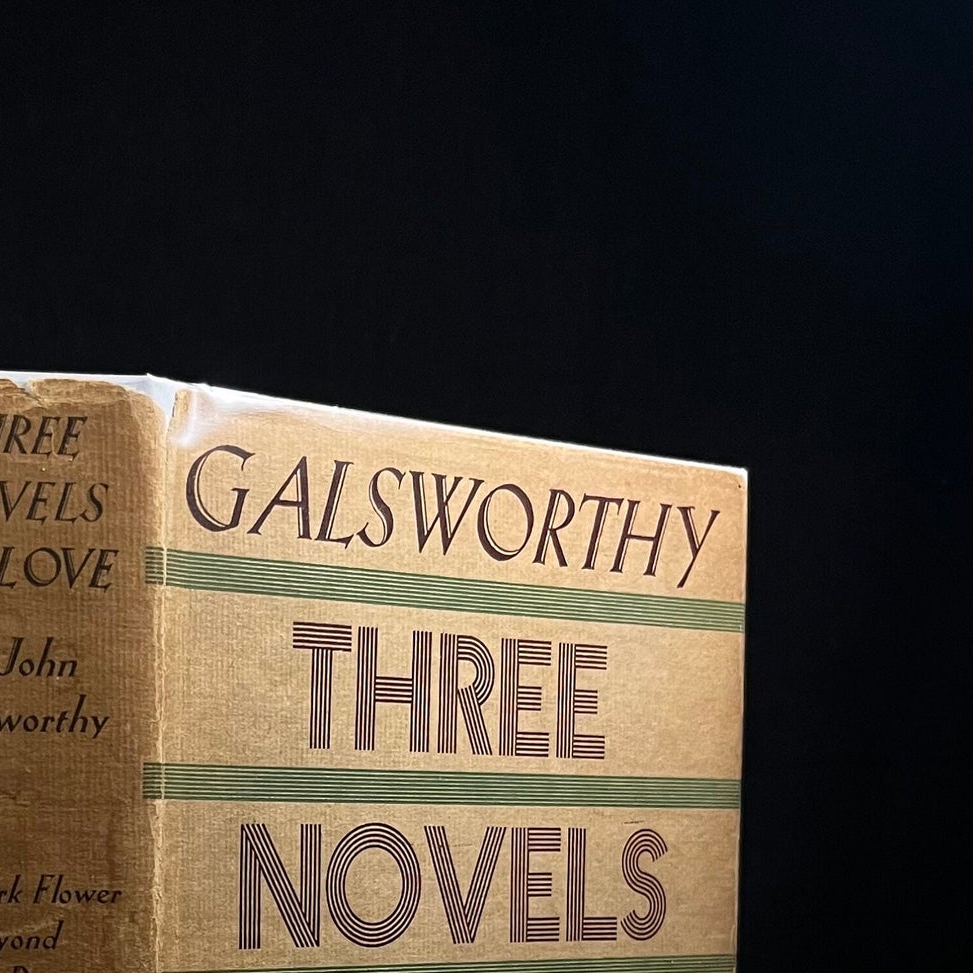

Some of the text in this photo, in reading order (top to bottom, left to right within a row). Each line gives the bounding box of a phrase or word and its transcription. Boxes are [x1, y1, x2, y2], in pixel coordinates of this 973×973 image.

[185, 444, 721, 588] GALSWORTHY
[293, 622, 607, 759] THREE
[33, 874, 122, 904] Flower
[239, 823, 668, 950] NOVELS
